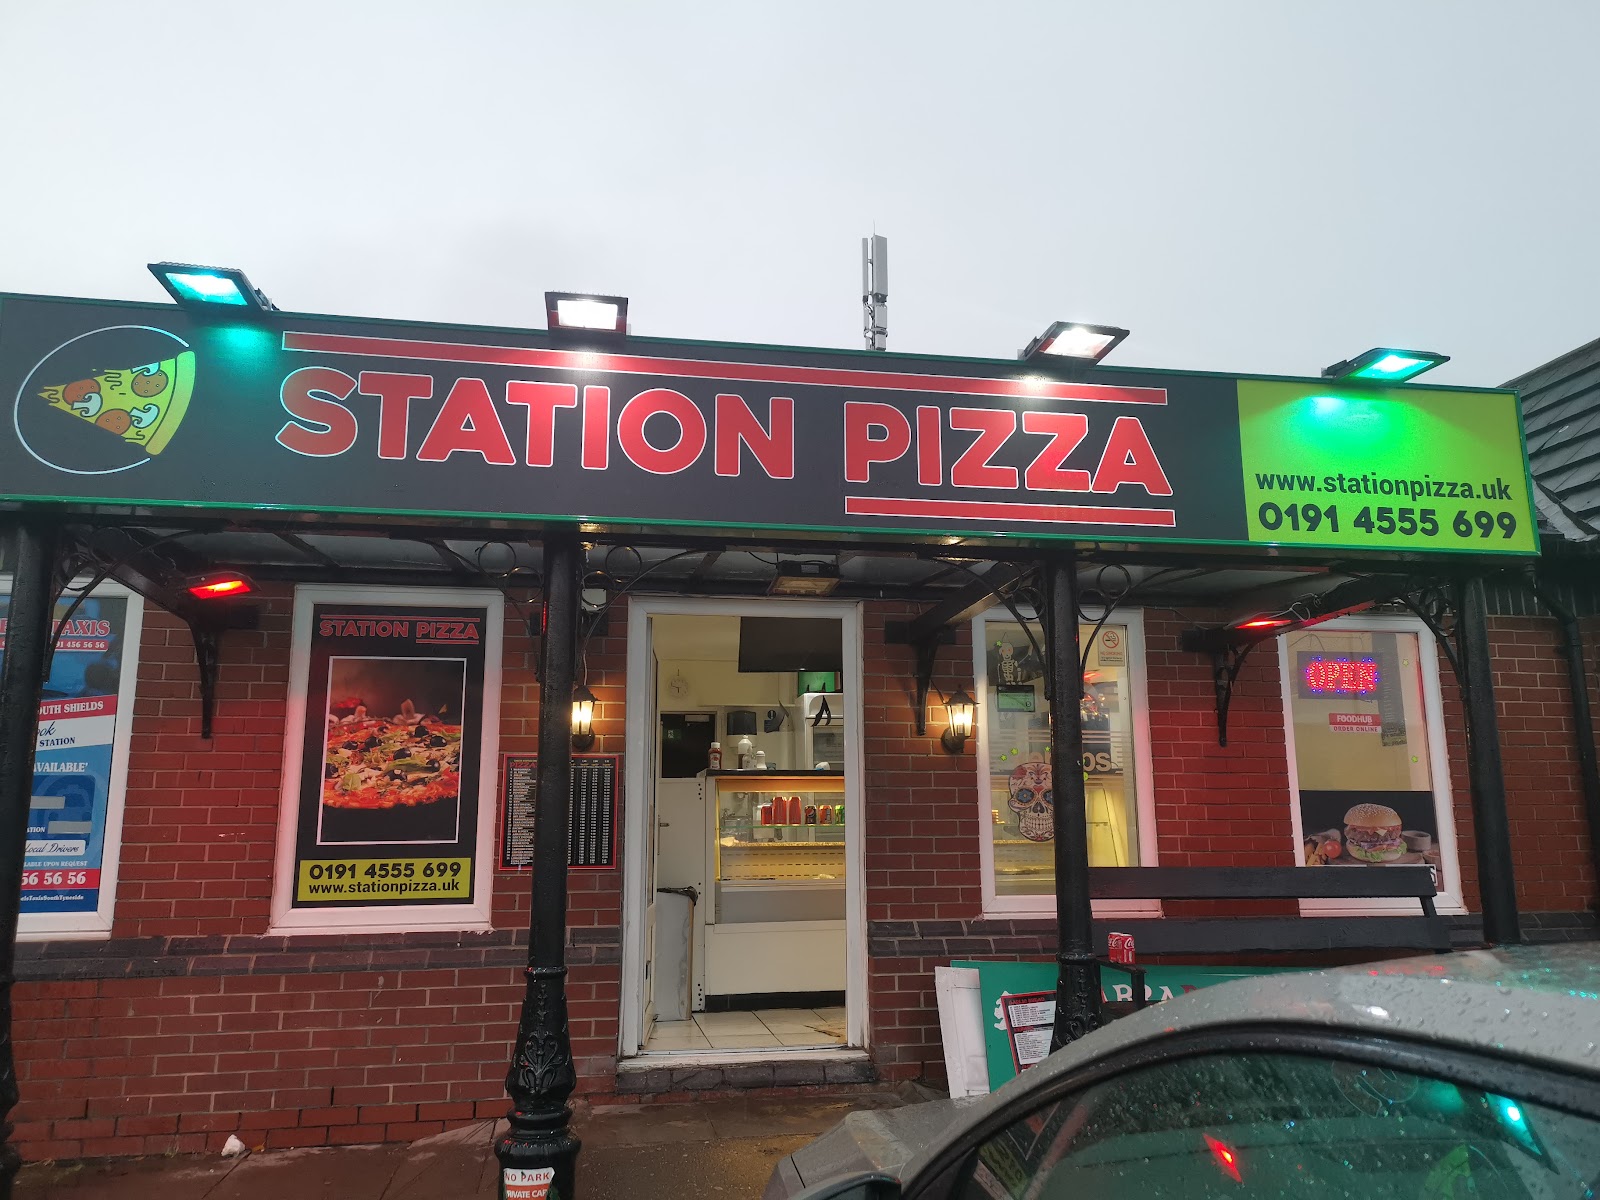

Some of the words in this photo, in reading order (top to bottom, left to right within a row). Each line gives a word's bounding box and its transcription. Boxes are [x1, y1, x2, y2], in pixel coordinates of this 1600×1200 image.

[276, 366, 794, 479] STATION
[844, 401, 1173, 496] PIZZA
[1255, 472, 1513, 501] www.stationpizza.uk
[1258, 502, 1340, 532] 0191
[1353, 506, 1439, 536] 4555
[1453, 510, 1517, 539] 699
[319, 620, 409, 637] STATION
[416, 622, 479, 639] PIZZA
[1308, 662, 1377, 690] OPEN
[63, 700, 104, 713] SHIELDS
[1336, 714, 1373, 723] FOODHUB
[37, 721, 56, 736] ok
[39, 737, 76, 747] STATION
[48, 842, 80, 853] Drivers
[60, 860, 88, 868] REQUEST
[309, 864, 356, 880] 0191
[364, 862, 415, 878] 4555
[422, 862, 462, 878] 699
[43, 872, 62, 885] 56
[67, 871, 87, 885] 56
[309, 879, 460, 895] www.stationpizza.uk
